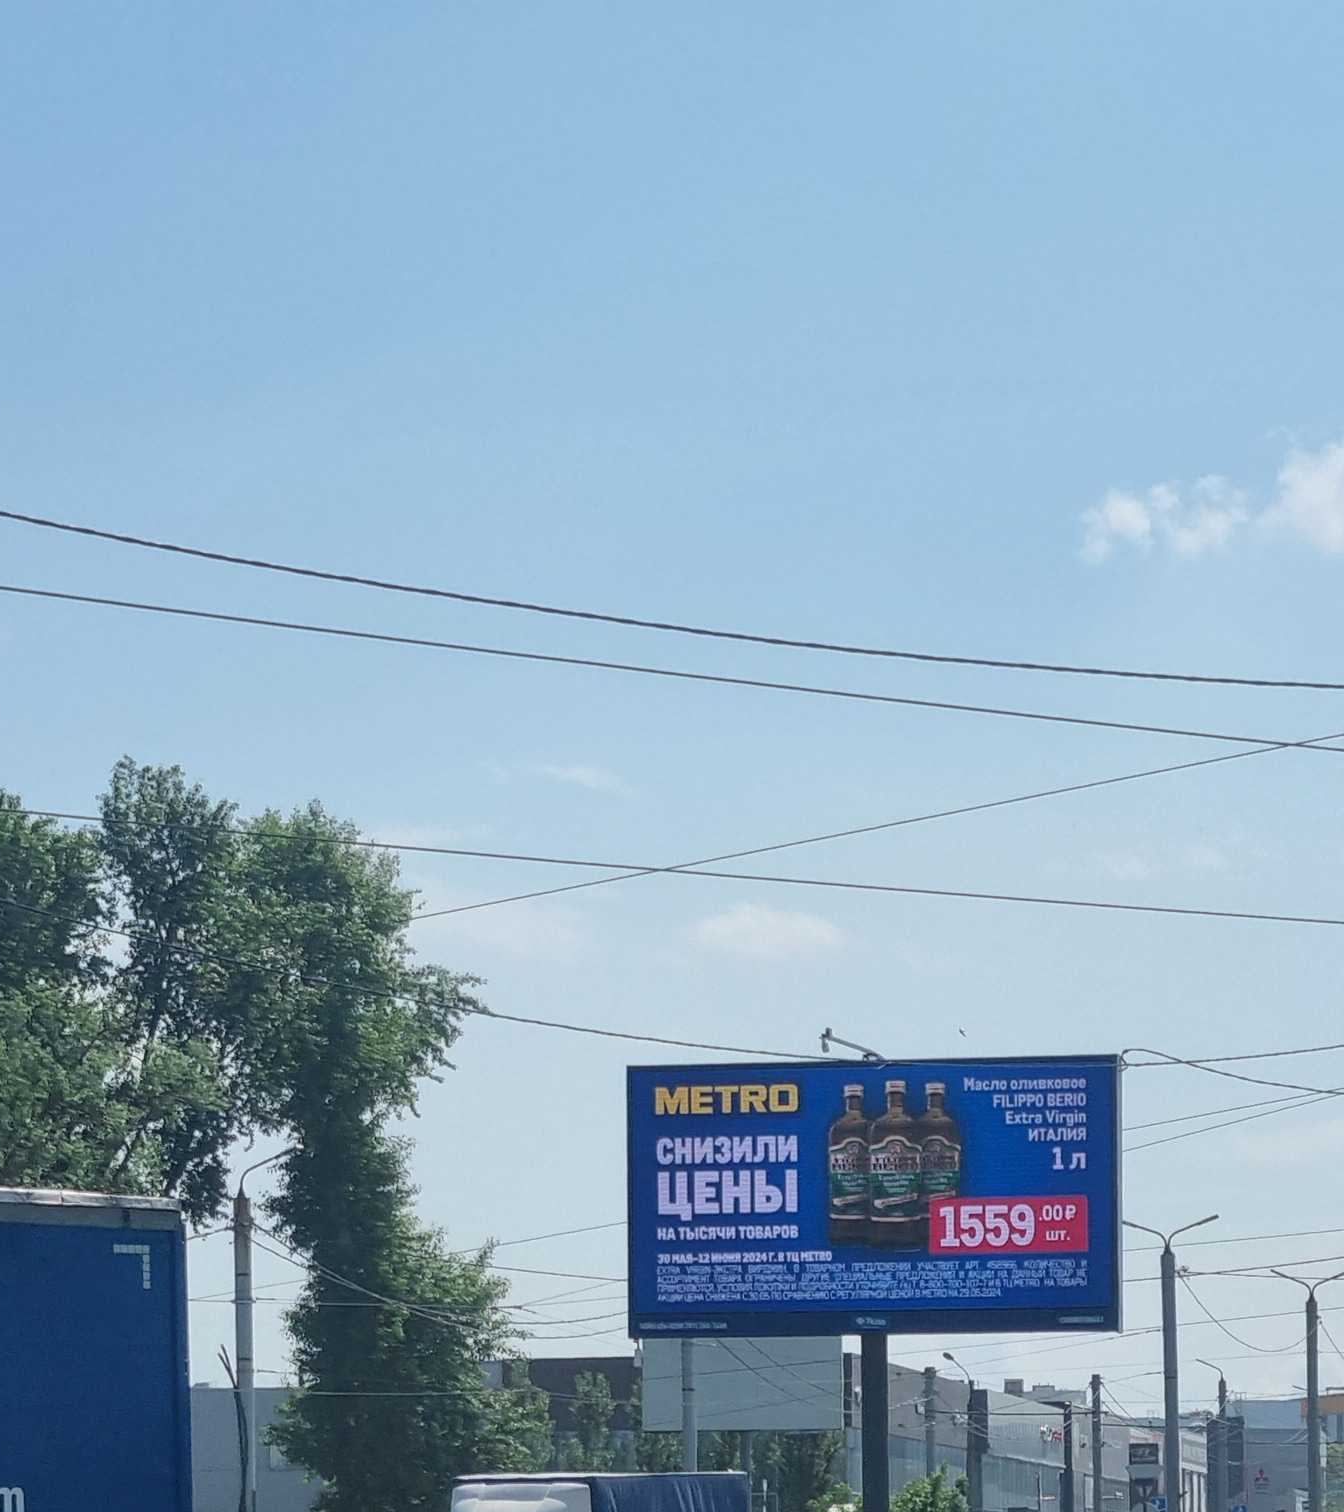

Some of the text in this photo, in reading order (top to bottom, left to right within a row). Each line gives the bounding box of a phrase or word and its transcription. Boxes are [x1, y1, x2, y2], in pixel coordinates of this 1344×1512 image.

[963, 1077, 1087, 1092] Масло оливковое
[655, 1083, 800, 1115] METRO
[992, 1093, 1087, 1108] FILIPPO BERIO
[1005, 1110, 1087, 1127] Extra Virgin
[1028, 1128, 1087, 1142] ИТАЛИЯ
[656, 1135, 799, 1165] СНИЗИЛИ
[1052, 1147, 1087, 1170] 1 л
[657, 1169, 799, 1222] ЦЕНЫ
[657, 1224, 800, 1241] НА ТЫСЯЧИ ТОВАРОВ
[939, 1203, 1036, 1248] 1559
[1045, 1230, 1071, 1241] шт.
[742, 1252, 767, 1263] 2024
[800, 1251, 833, 1262] METRO
